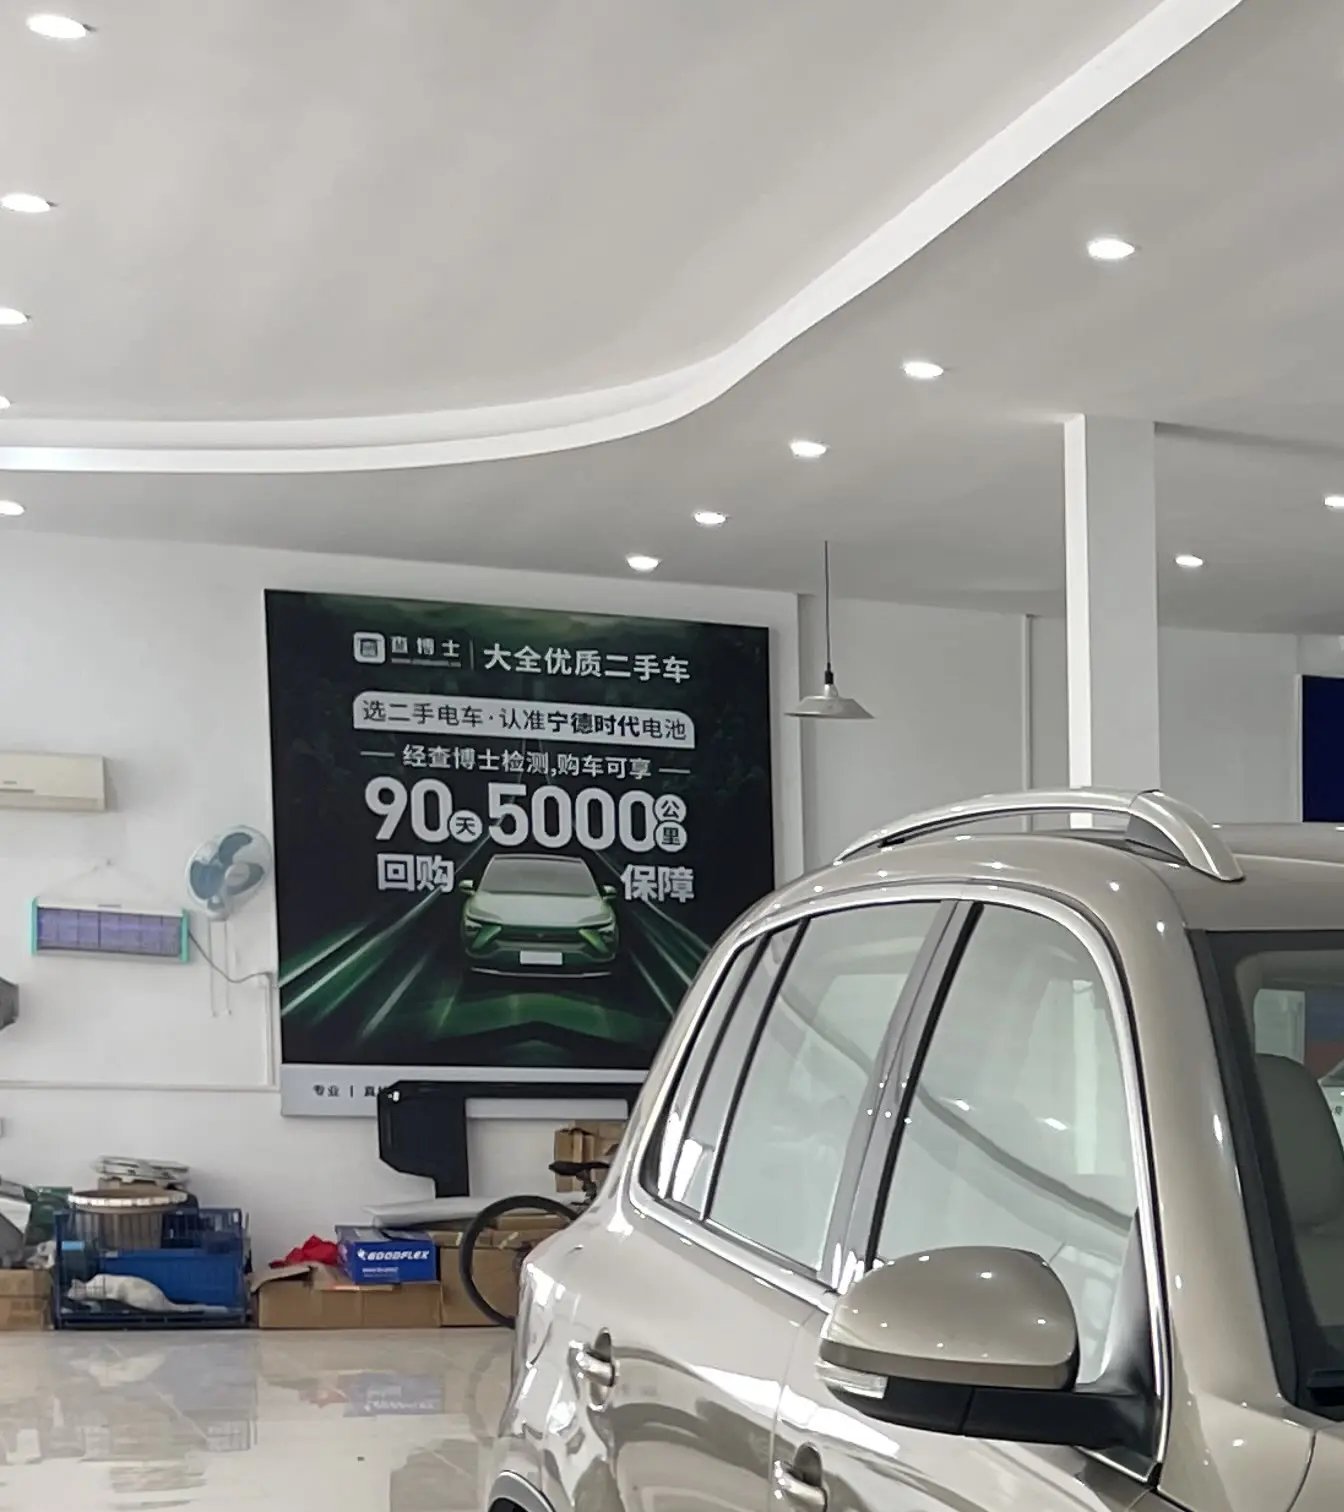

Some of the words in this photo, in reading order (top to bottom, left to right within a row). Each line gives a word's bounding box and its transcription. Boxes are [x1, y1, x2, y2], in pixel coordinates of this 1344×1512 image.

[483, 643, 691, 683] 大全优质二手车
[376, 853, 455, 893] 回购
[620, 863, 696, 904] 保障
